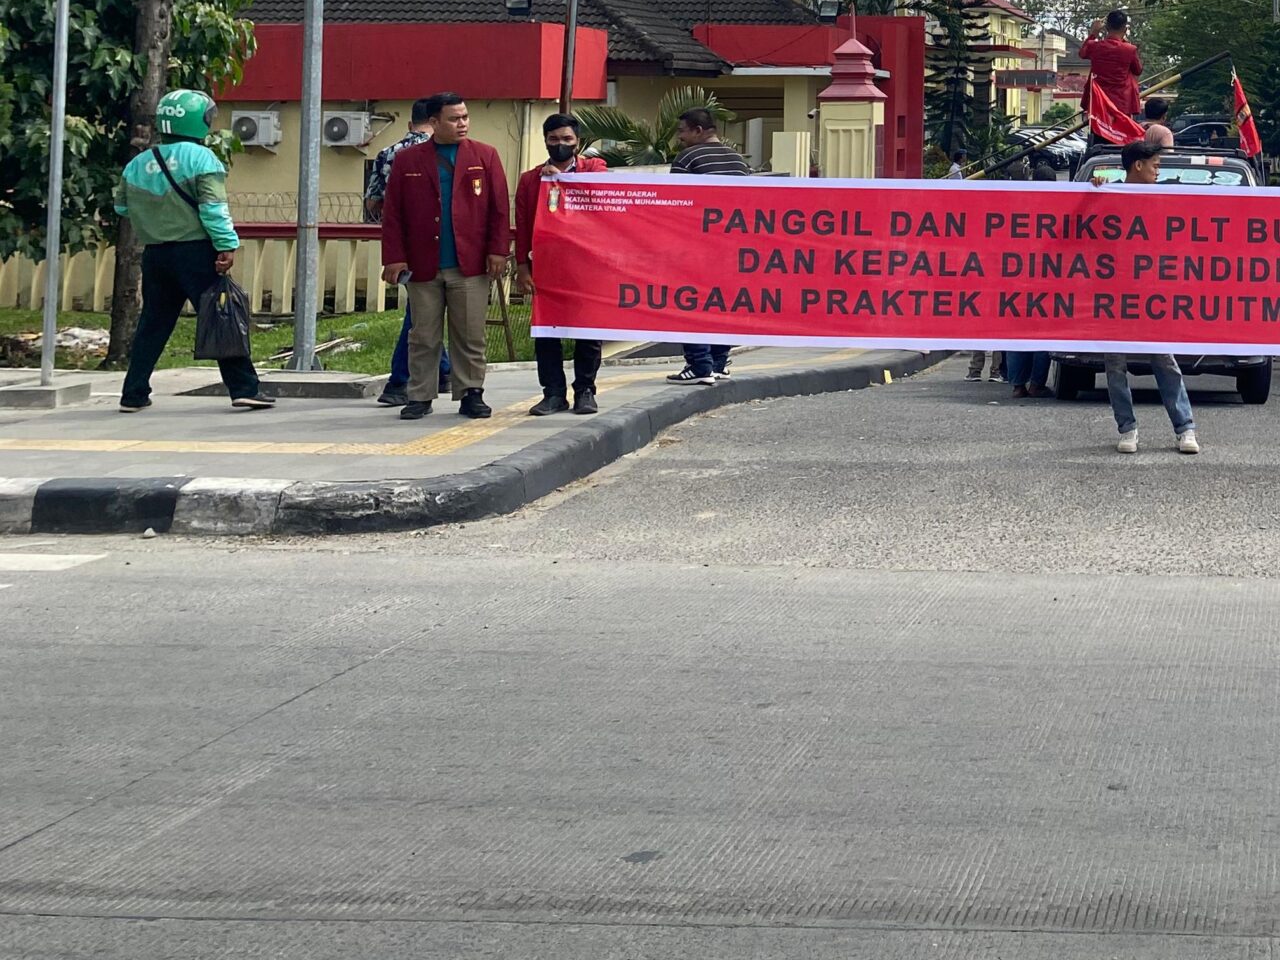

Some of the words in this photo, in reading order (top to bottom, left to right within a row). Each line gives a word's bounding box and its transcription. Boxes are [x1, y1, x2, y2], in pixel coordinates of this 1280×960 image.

[590, 189, 626, 197] PIMPINAN
[591, 197, 633, 205] MAHASISWA
[634, 199, 694, 207] MUHAMMADIYAH
[564, 203, 603, 211] SUMATERA
[702, 207, 873, 236] PANGGIL
[890, 211, 966, 237] DAN
[985, 212, 1149, 241] PERIKSA
[1165, 216, 1230, 243] PLT
[738, 247, 815, 275] DAN
[834, 249, 985, 277] KEPALA
[1001, 252, 1116, 280] DINAS
[618, 283, 782, 314] DUGAAN
[801, 288, 981, 317] PRAKTEK
[998, 291, 1075, 318] KKN
